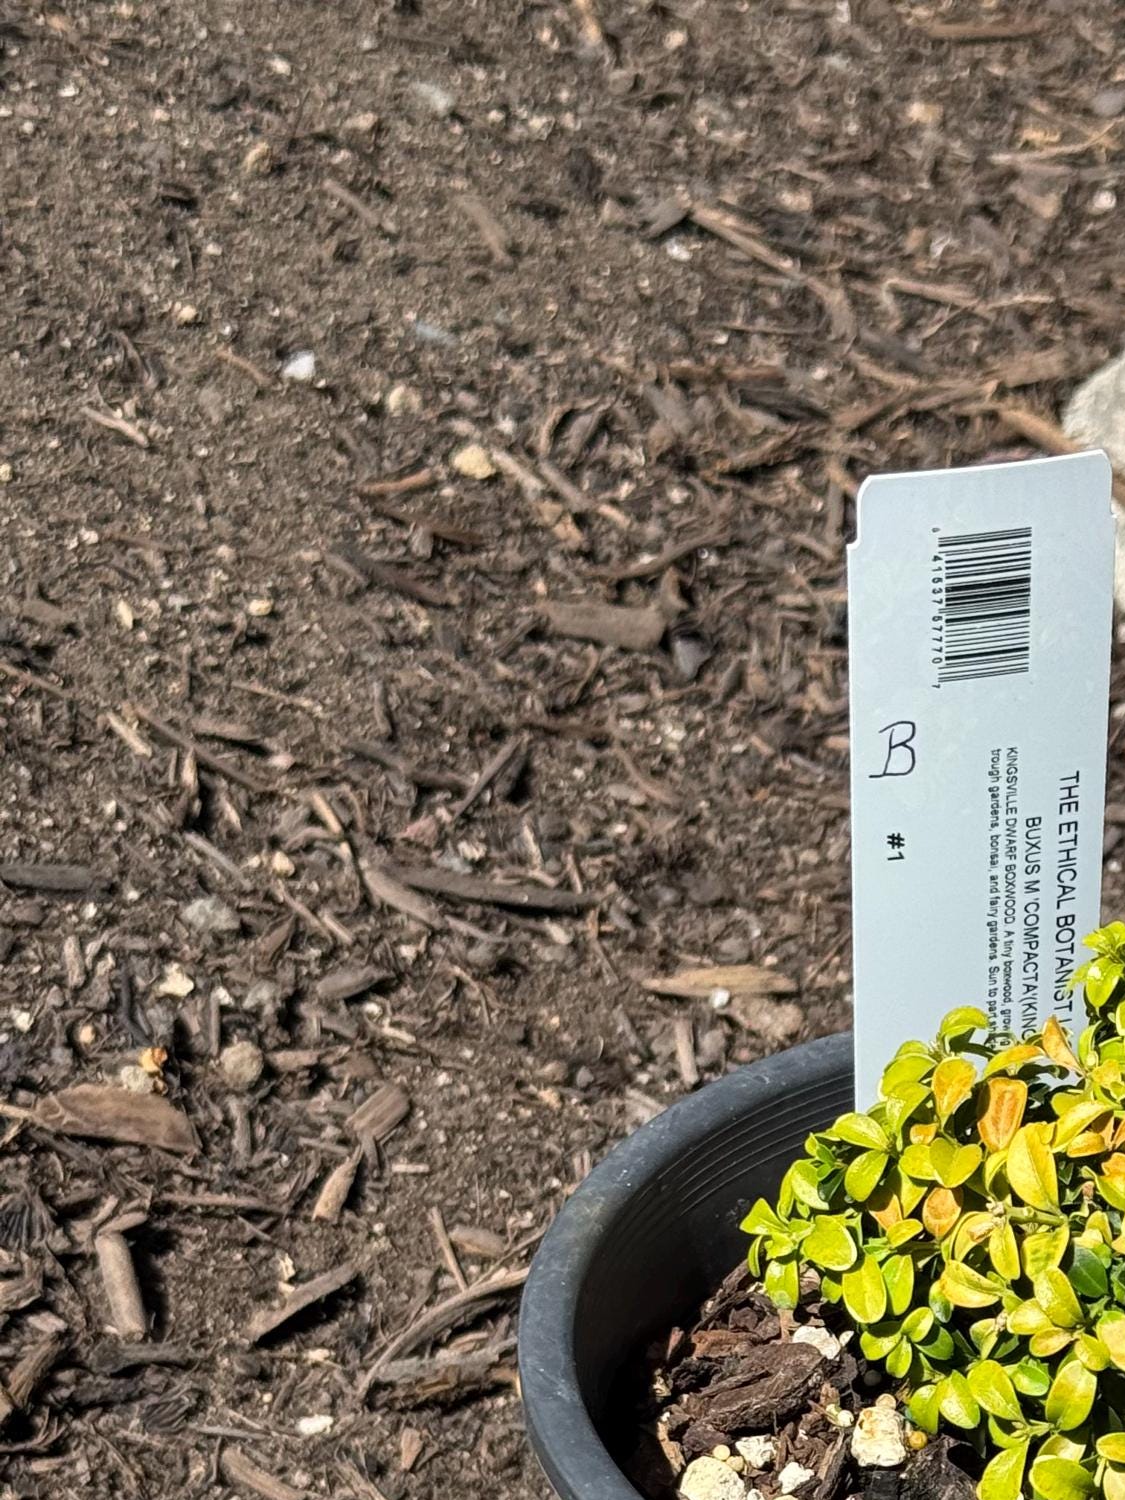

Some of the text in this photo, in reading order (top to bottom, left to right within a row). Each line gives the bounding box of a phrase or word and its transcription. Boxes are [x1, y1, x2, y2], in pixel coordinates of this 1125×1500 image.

[868, 720, 916, 779] B
[988, 748, 1002, 783] trough
[1005, 746, 1018, 816] KINGSVILLE
[1059, 770, 1080, 815] THE
[988, 785, 1002, 832] gardens,
[886, 832, 905, 861] #1
[988, 834, 1002, 872] bonsai,
[1005, 818, 1018, 861] DWARF
[1024, 816, 1042, 876] BUXUS
[1056, 820, 1079, 910] ETHICAL
[989, 874, 1001, 894] and
[1024, 879, 1041, 894] M
[987, 896, 1000, 918] fairy
[1001, 939, 1014, 958] tiny
[1003, 930, 1015, 939] A
[988, 966, 1000, 986] Sun
[1053, 913, 1076, 1012] BOTANIST
[988, 987, 999, 998] to
[1000, 959, 1015, 1007] boxwood,
[986, 1001, 999, 1020] part
